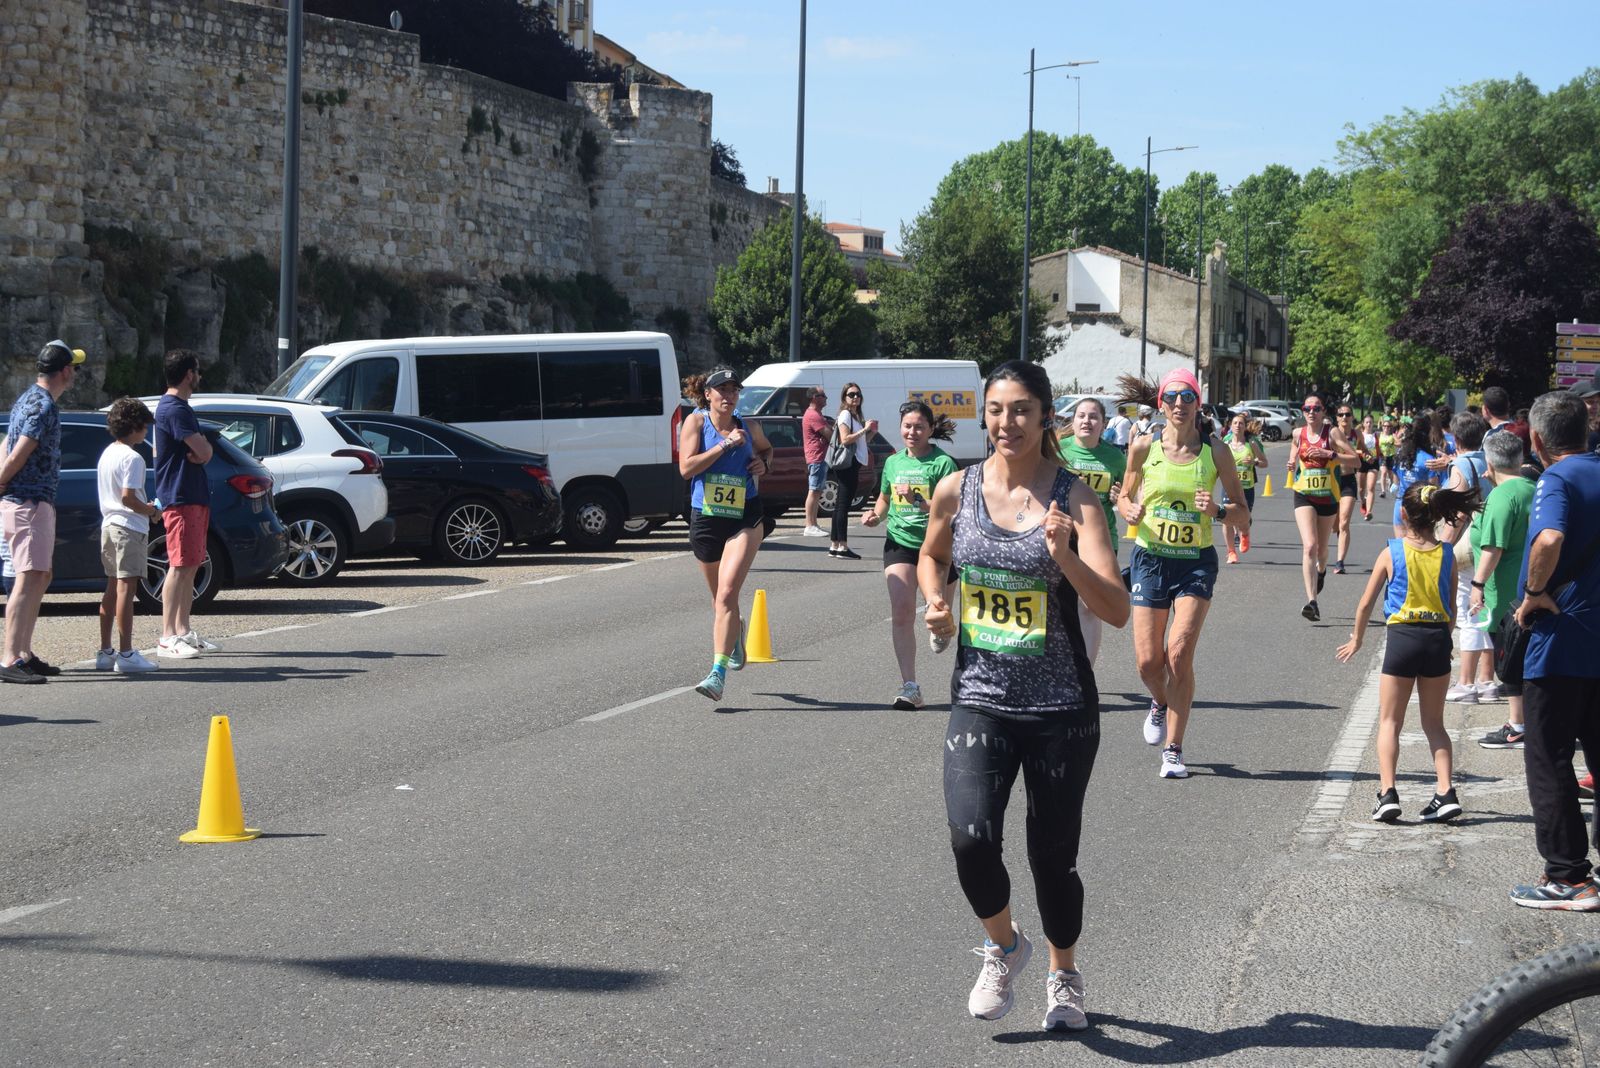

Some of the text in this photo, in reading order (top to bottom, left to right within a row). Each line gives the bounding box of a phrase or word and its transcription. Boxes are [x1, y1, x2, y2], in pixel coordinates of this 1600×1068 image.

[1079, 472, 1103, 489] 17
[1306, 476, 1327, 489] 107
[714, 486, 736, 505] 54
[1157, 521, 1194, 544] 103
[1161, 547, 1176, 555] CAJA
[984, 580, 1035, 590] CAJA RURAL
[971, 590, 1033, 629] 185
[979, 632, 1039, 649] CAJA RURAL
